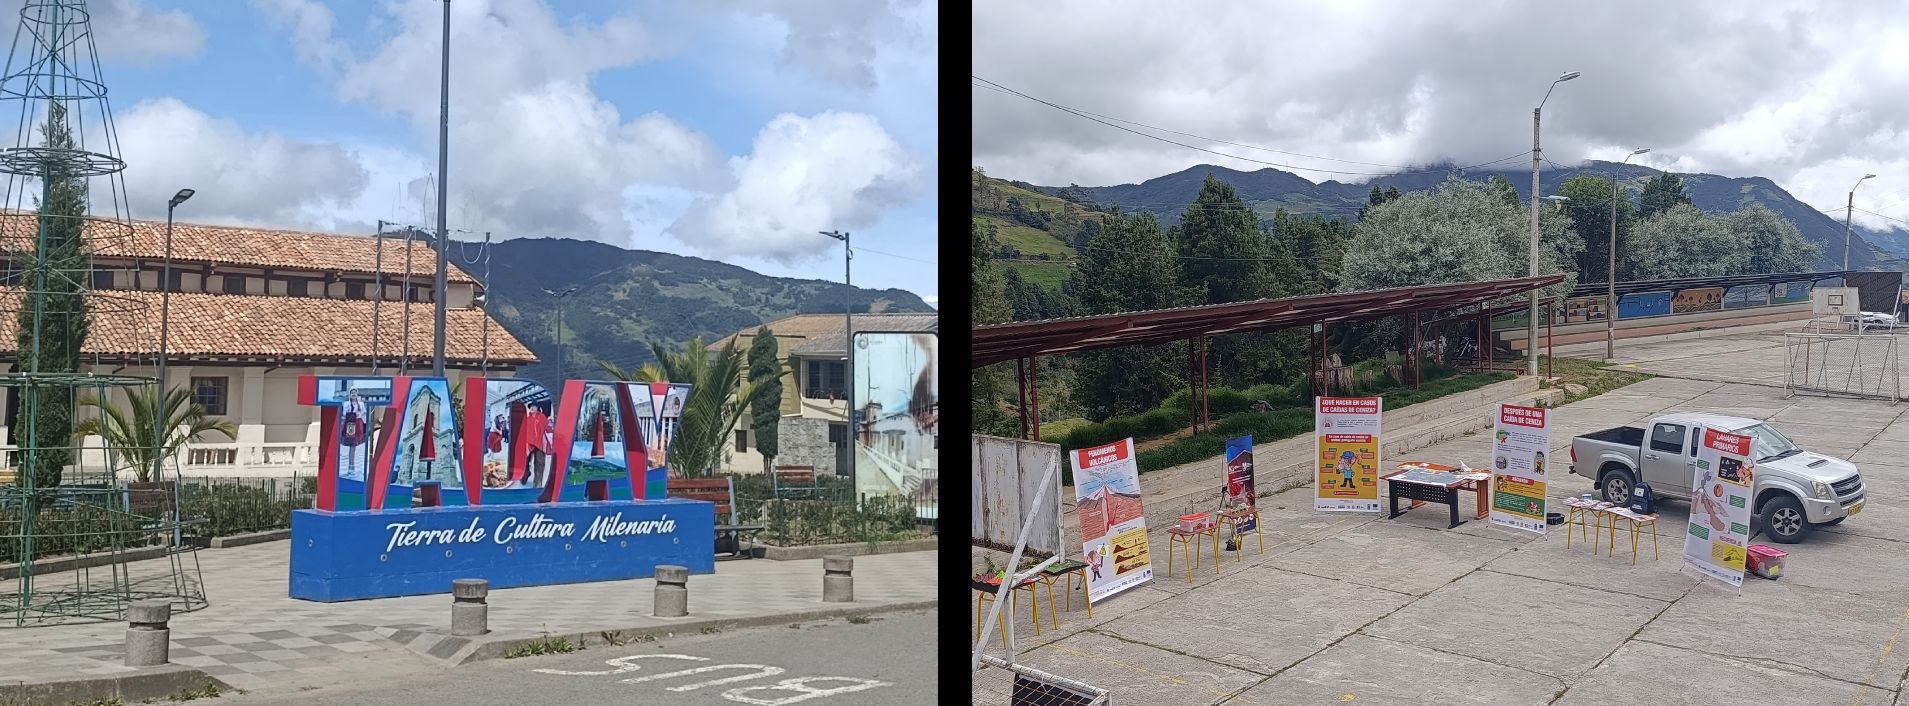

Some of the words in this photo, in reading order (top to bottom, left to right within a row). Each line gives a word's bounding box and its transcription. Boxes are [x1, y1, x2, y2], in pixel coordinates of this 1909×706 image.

[1504, 407, 1525, 416] DESPUÉS
[1532, 410, 1543, 418] UNA
[1518, 416, 1525, 424] DE
[1525, 417, 1542, 426] CENIZA
[298, 375, 692, 512] TADAY
[1716, 433, 1740, 445] LAHARES
[1712, 440, 1740, 453] PRIMARIOS
[386, 521, 455, 553] Tierra
[458, 516, 486, 543] de
[494, 512, 576, 544] Cultura
[580, 511, 676, 543] Milenaria
[531, 653, 894, 706] BUS
